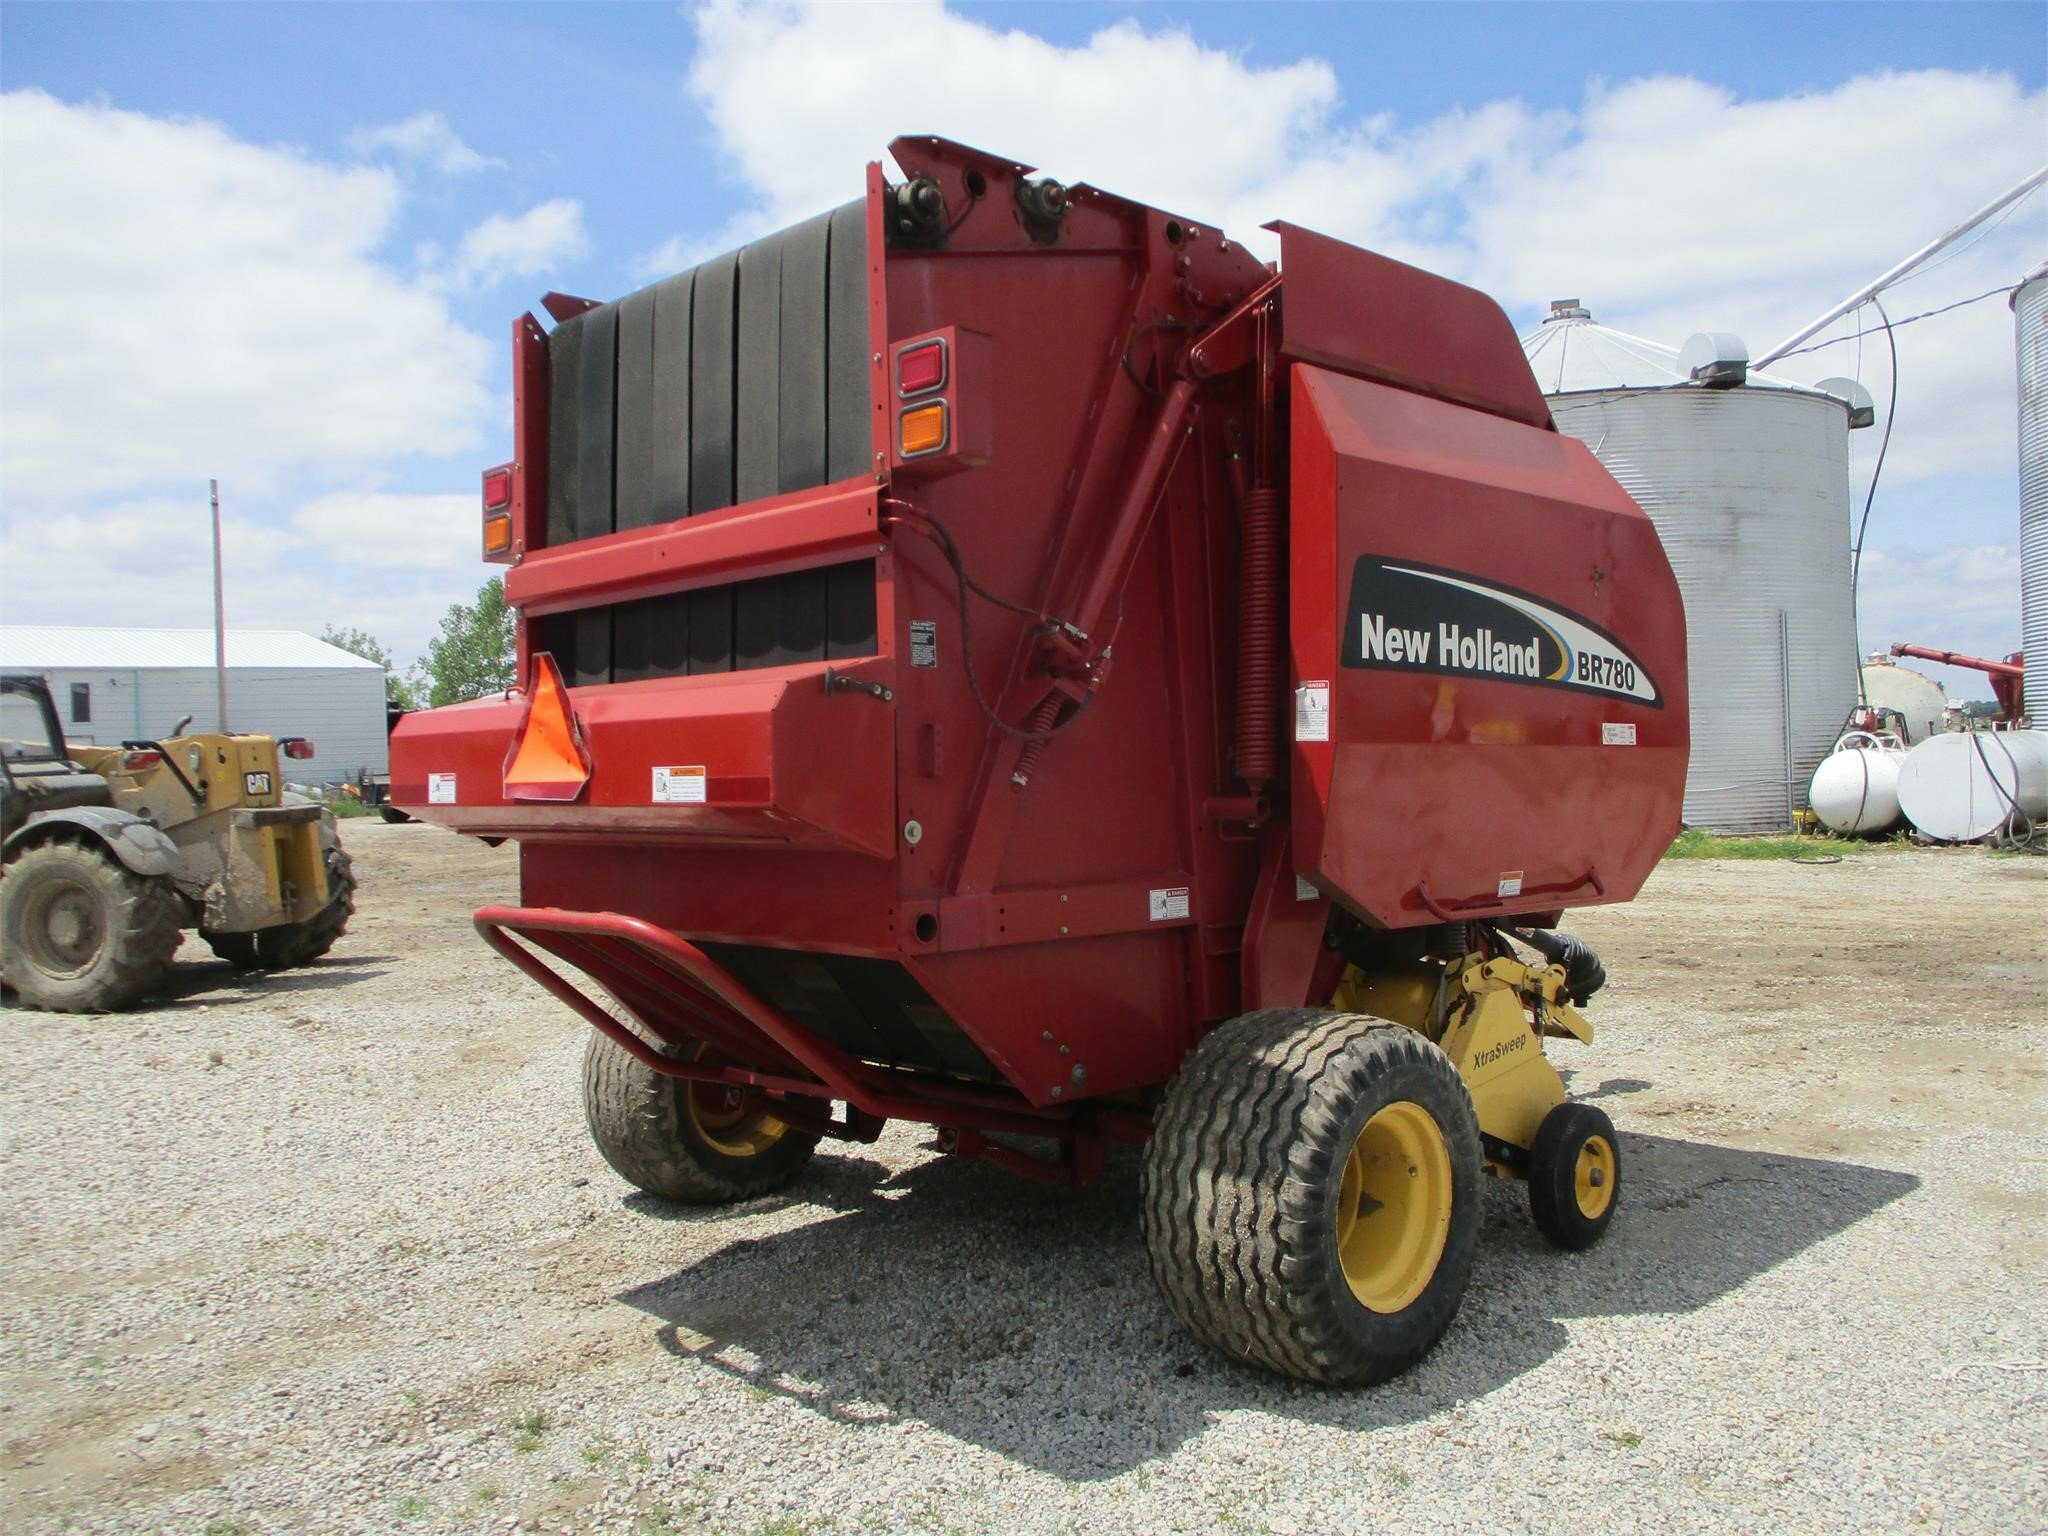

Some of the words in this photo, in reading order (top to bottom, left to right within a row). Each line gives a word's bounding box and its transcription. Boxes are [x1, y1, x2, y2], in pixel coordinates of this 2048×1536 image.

[1361, 613, 1430, 664] New
[1439, 622, 1540, 678] Holland
[1577, 651, 1635, 691] BR780
[247, 774, 269, 794] CAT
[1473, 1034, 1526, 1071] XtraSweep
